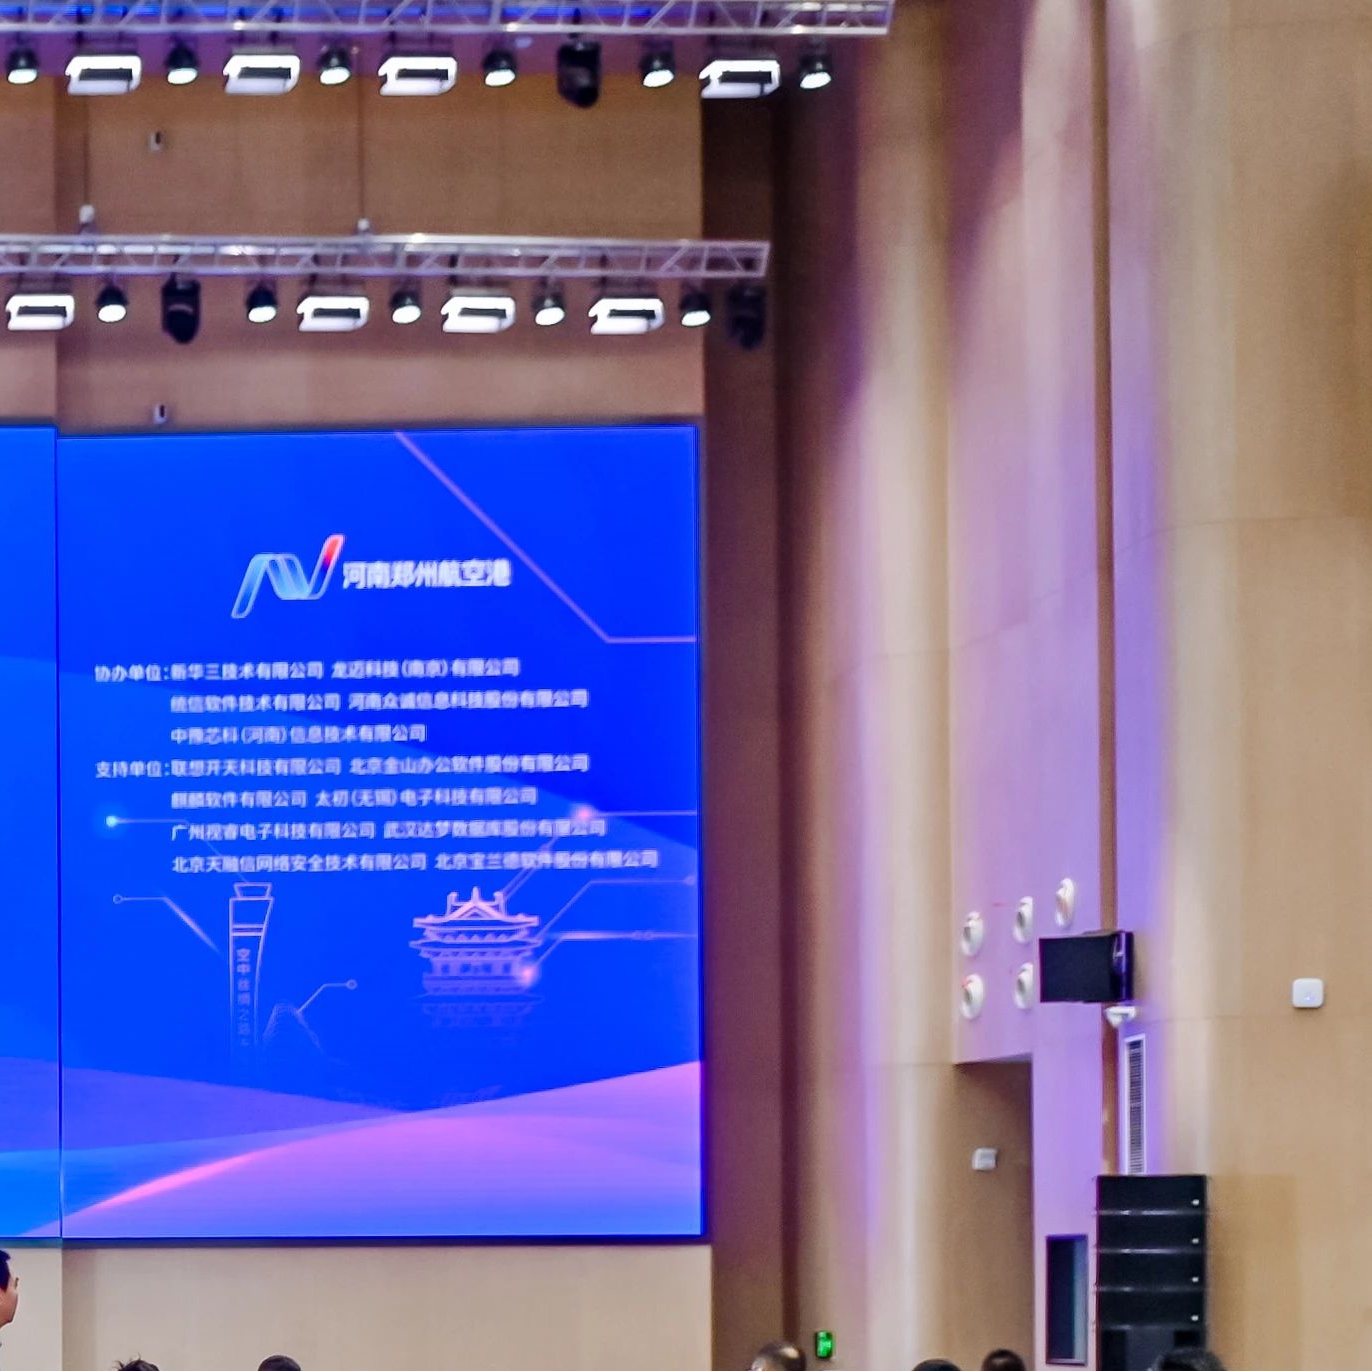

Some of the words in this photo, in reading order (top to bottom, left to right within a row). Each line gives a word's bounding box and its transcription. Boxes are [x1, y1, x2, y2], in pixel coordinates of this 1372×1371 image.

[343, 559, 511, 589] 河南郑州航空港
